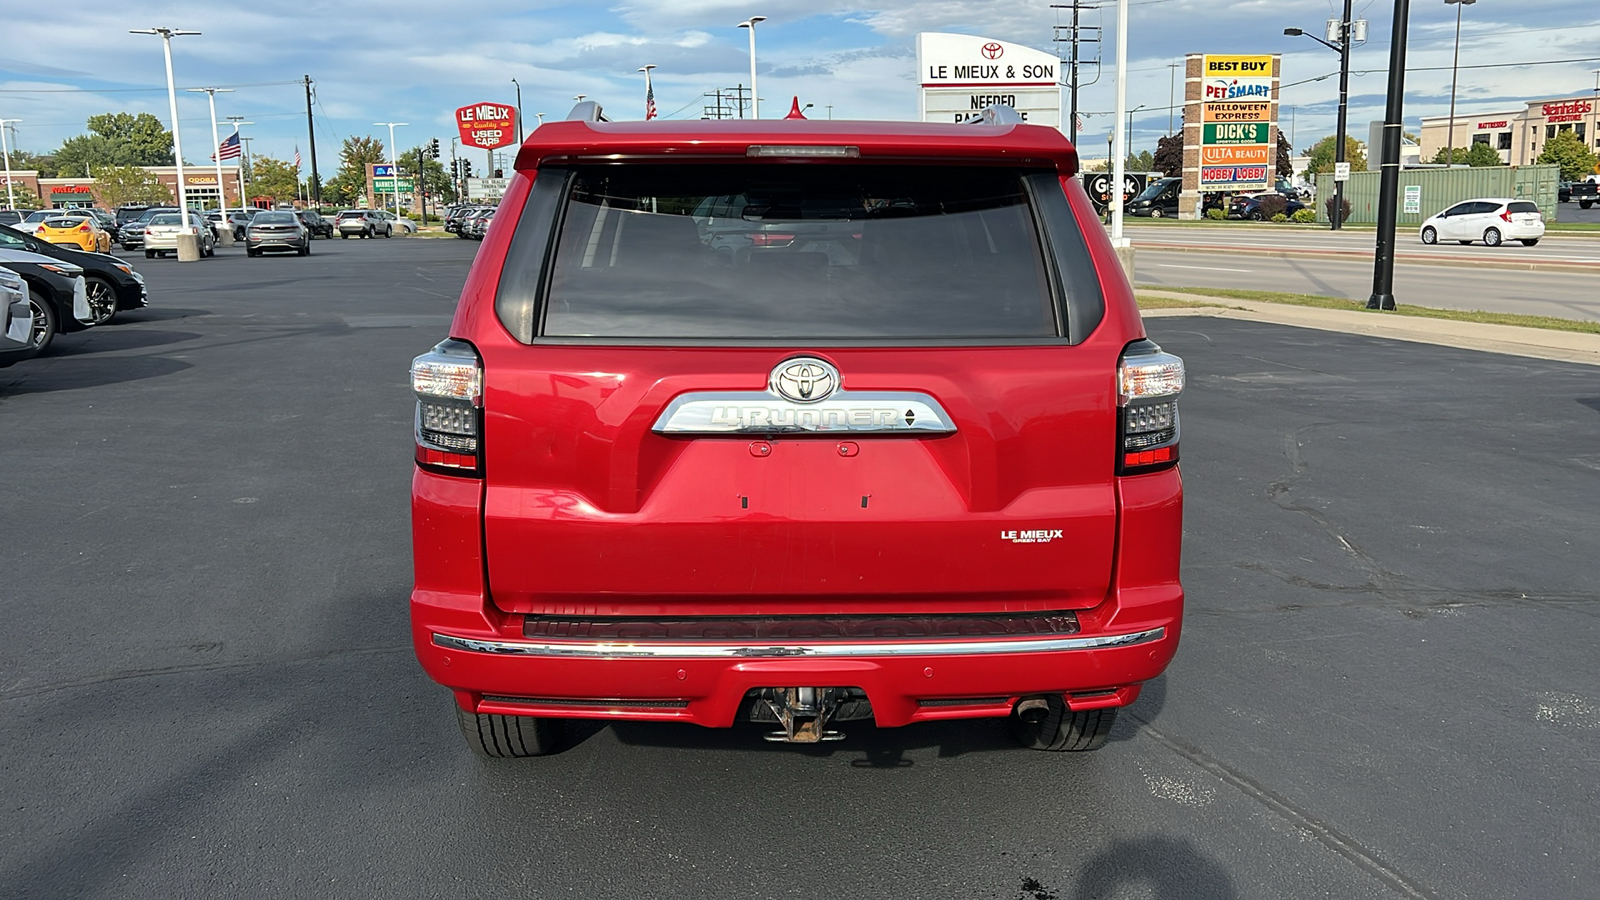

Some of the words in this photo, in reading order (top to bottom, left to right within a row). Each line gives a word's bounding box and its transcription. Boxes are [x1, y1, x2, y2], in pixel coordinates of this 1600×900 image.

[930, 65, 947, 79] LE
[954, 65, 999, 79] MIEUX
[1006, 65, 1016, 78] &
[1023, 65, 1054, 78] SON
[1209, 62, 1239, 71] BEST
[1241, 62, 1268, 71] BUY
[970, 94, 1016, 109] NEEDED
[460, 109, 474, 121] LE
[475, 105, 510, 121] MIEUX
[1541, 100, 1592, 116] Steinhafels
[1215, 112, 1260, 120] EXPRESS
[473, 121, 498, 130] Quality
[471, 130, 503, 138] USED
[1216, 124, 1258, 139] DICK'S
[475, 137, 500, 146] CARS
[1207, 147, 1234, 159] ULTA
[1235, 149, 1267, 158] BEAUTY
[1202, 168, 1234, 180] HOBBY
[1236, 167, 1266, 179] LOBBY
[52, 186, 71, 194] NAIL
[1001, 530, 1018, 539] LE
[1020, 529, 1063, 539] MIEUX
